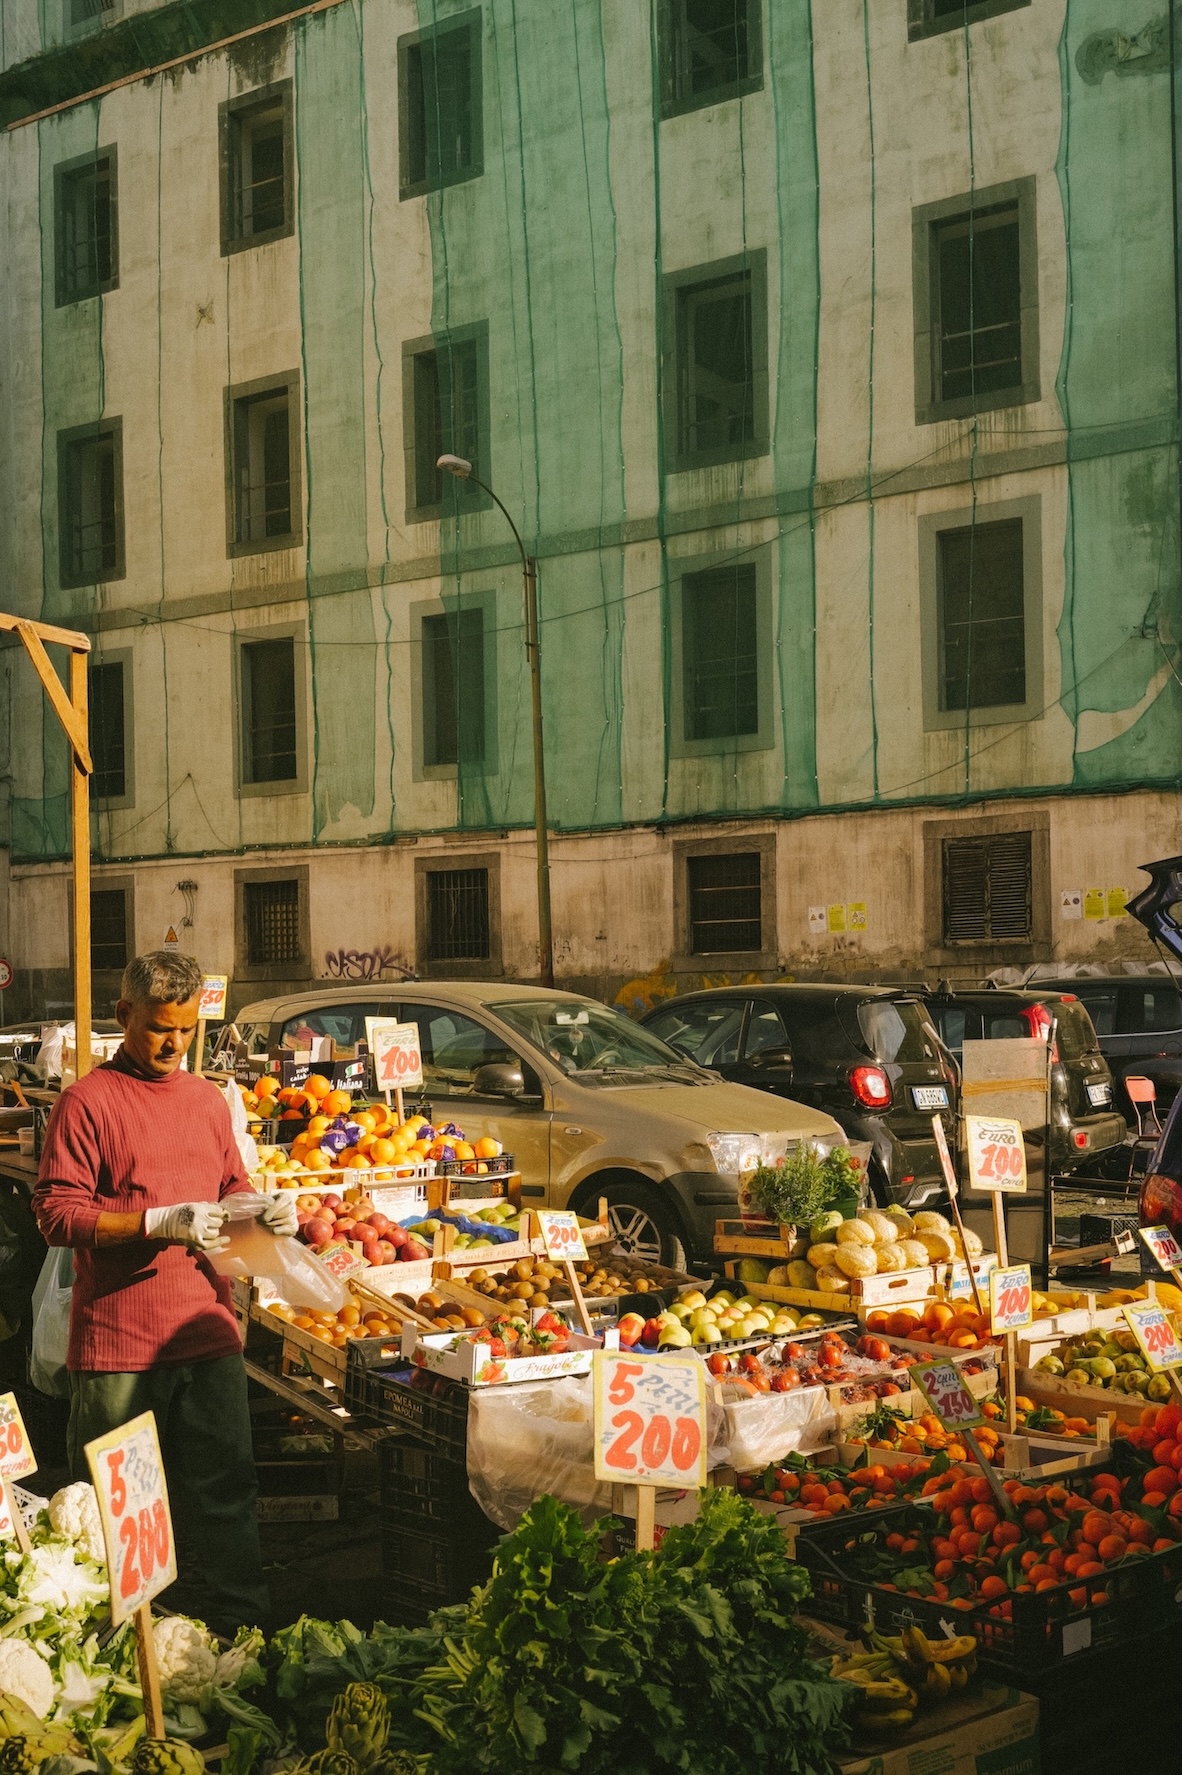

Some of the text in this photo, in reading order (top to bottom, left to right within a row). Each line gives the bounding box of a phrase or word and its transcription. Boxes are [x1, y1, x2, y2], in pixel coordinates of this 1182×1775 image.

[336, 1078, 363, 1090] Italiana
[978, 1129, 1017, 1145] EURO
[608, 1362, 644, 1406] 5
[923, 1371, 940, 1396] 2
[107, 1448, 127, 1518] 5
